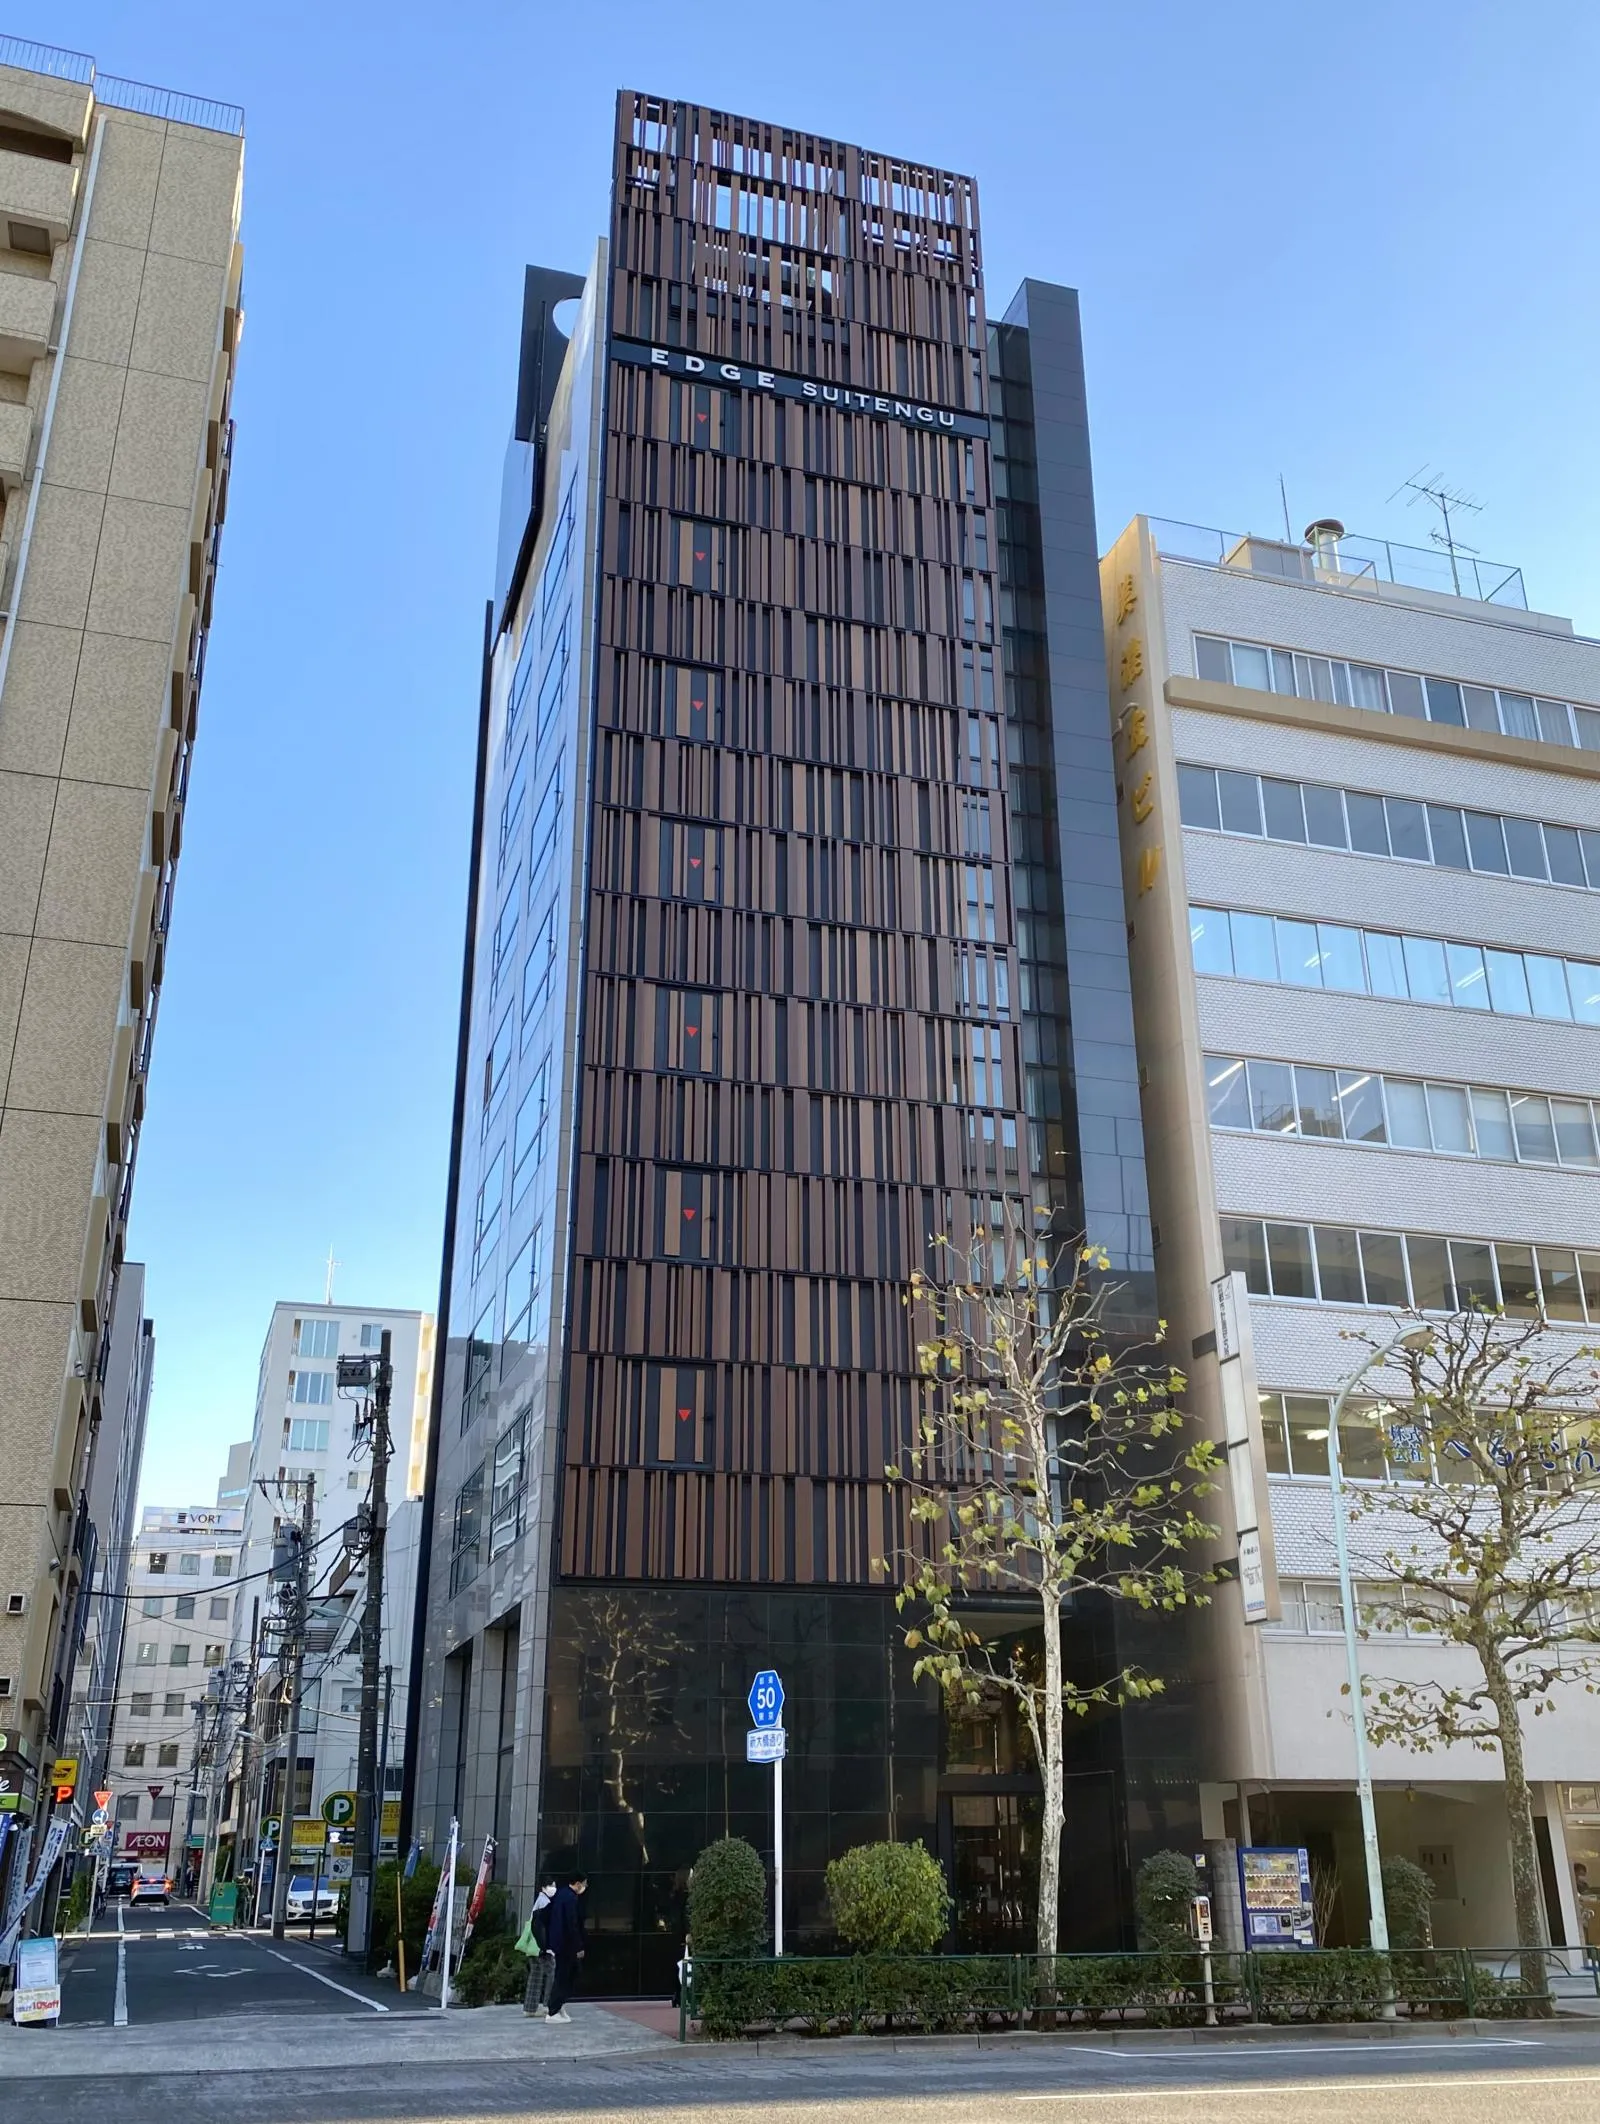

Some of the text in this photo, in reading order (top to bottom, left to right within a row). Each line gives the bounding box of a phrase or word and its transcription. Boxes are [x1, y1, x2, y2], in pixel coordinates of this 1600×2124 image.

[651, 348, 955, 427] EDGE SUITENGU
[190, 1513, 221, 1524] VORT
[757, 1686, 776, 1710] 50
[57, 1786, 73, 1802] P
[333, 1798, 350, 1820] P
[268, 1820, 280, 1836] P
